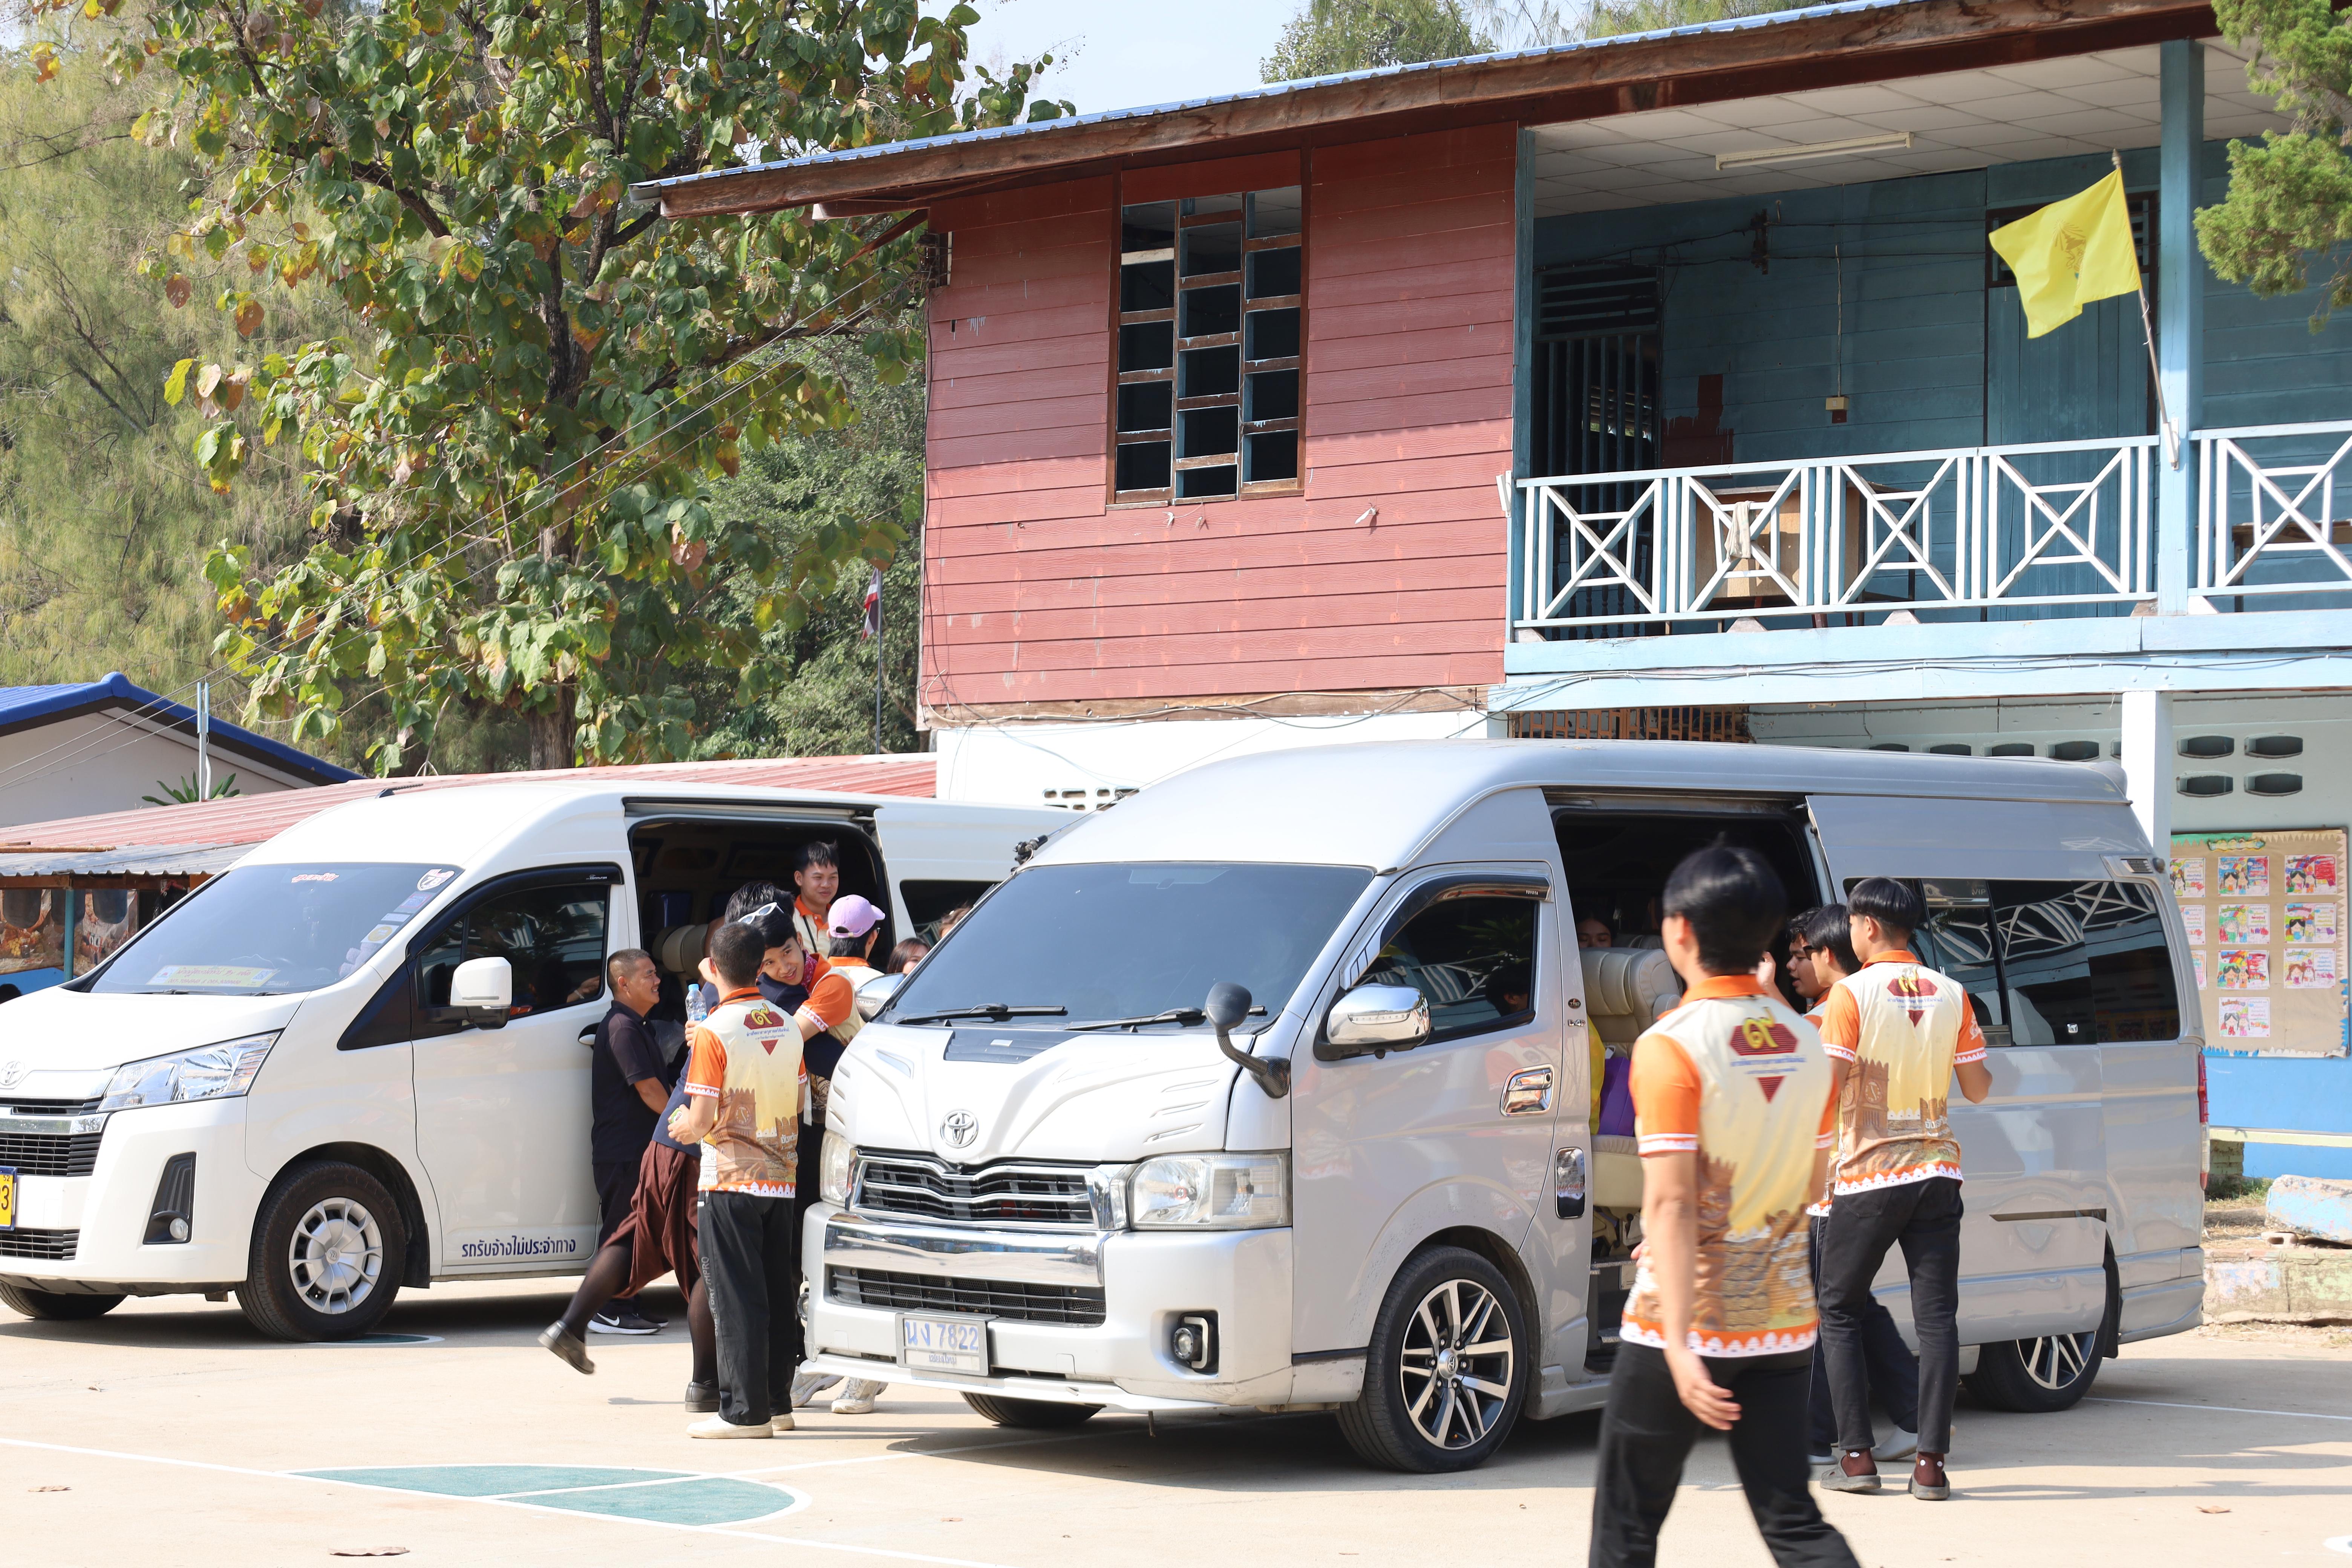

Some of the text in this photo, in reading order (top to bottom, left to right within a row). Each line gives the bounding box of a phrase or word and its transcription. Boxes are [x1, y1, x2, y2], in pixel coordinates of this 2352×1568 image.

[422, 876, 442, 886] 78
[462, 1235, 576, 1257] รถรับจ้างไม่ประจำทาง
[905, 1320, 979, 1351] นง 7822
